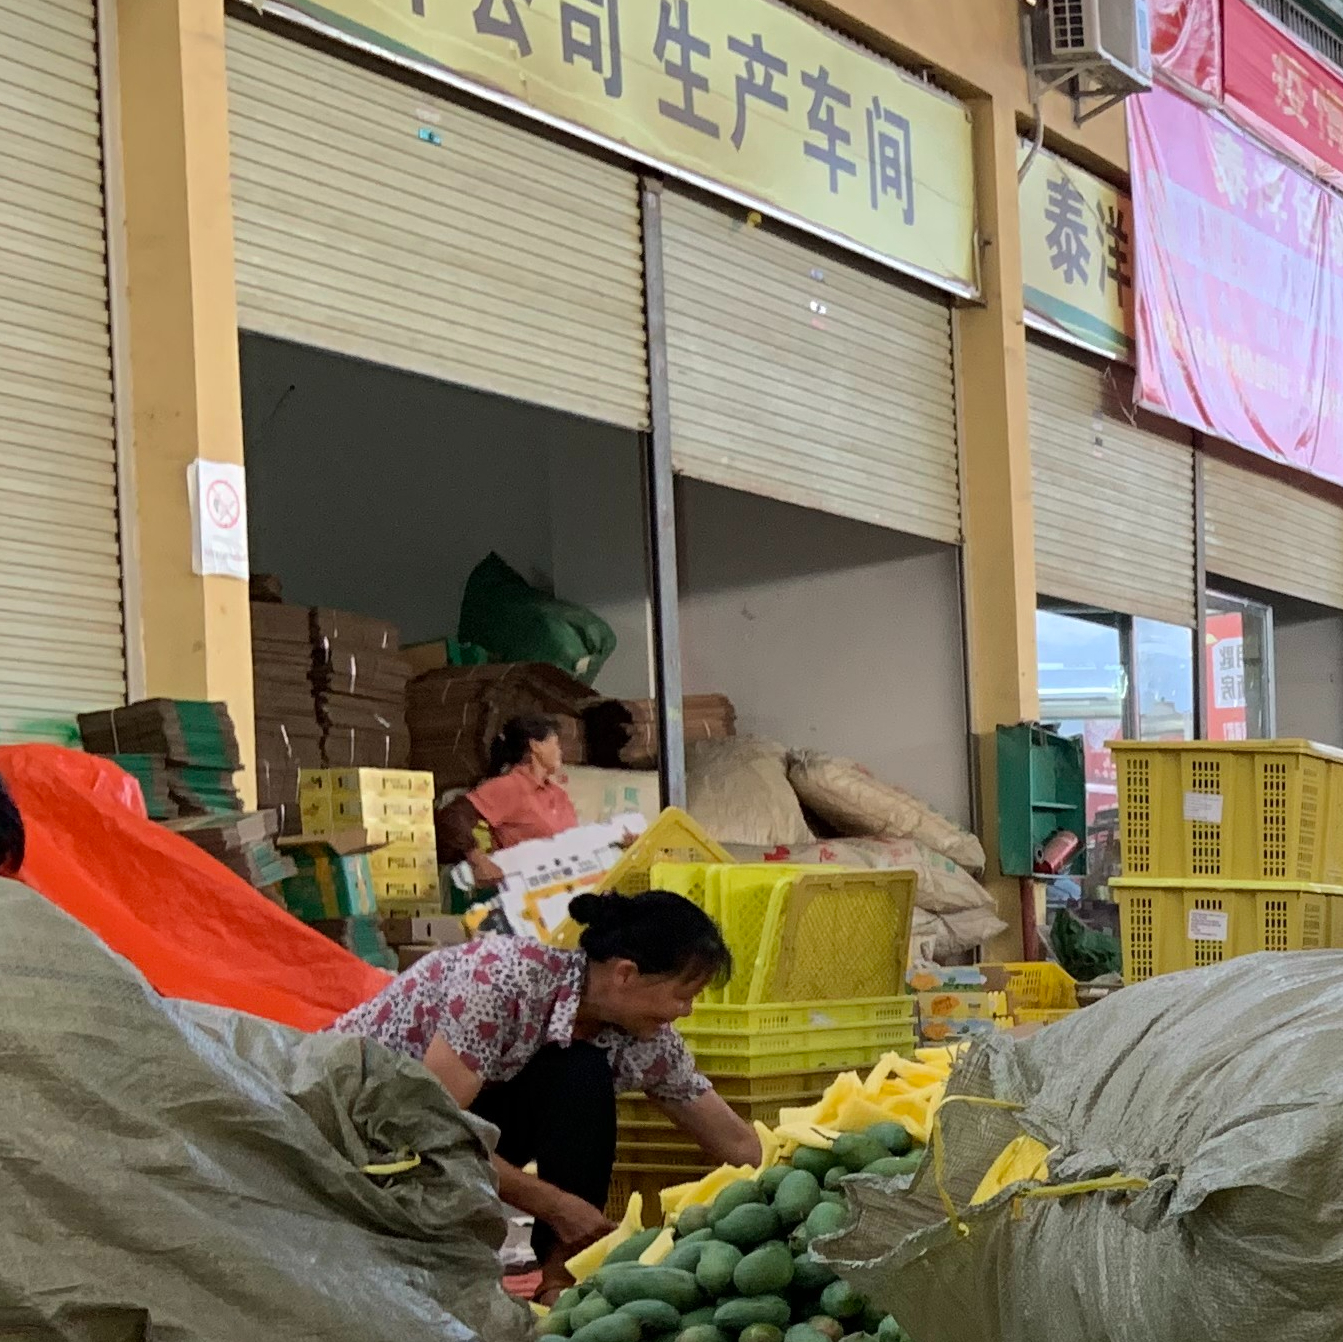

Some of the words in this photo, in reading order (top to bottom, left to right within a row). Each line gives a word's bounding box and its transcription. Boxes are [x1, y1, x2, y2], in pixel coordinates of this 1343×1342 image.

[412, 0, 623, 98] 公司
[653, 0, 915, 225] 生产车间
